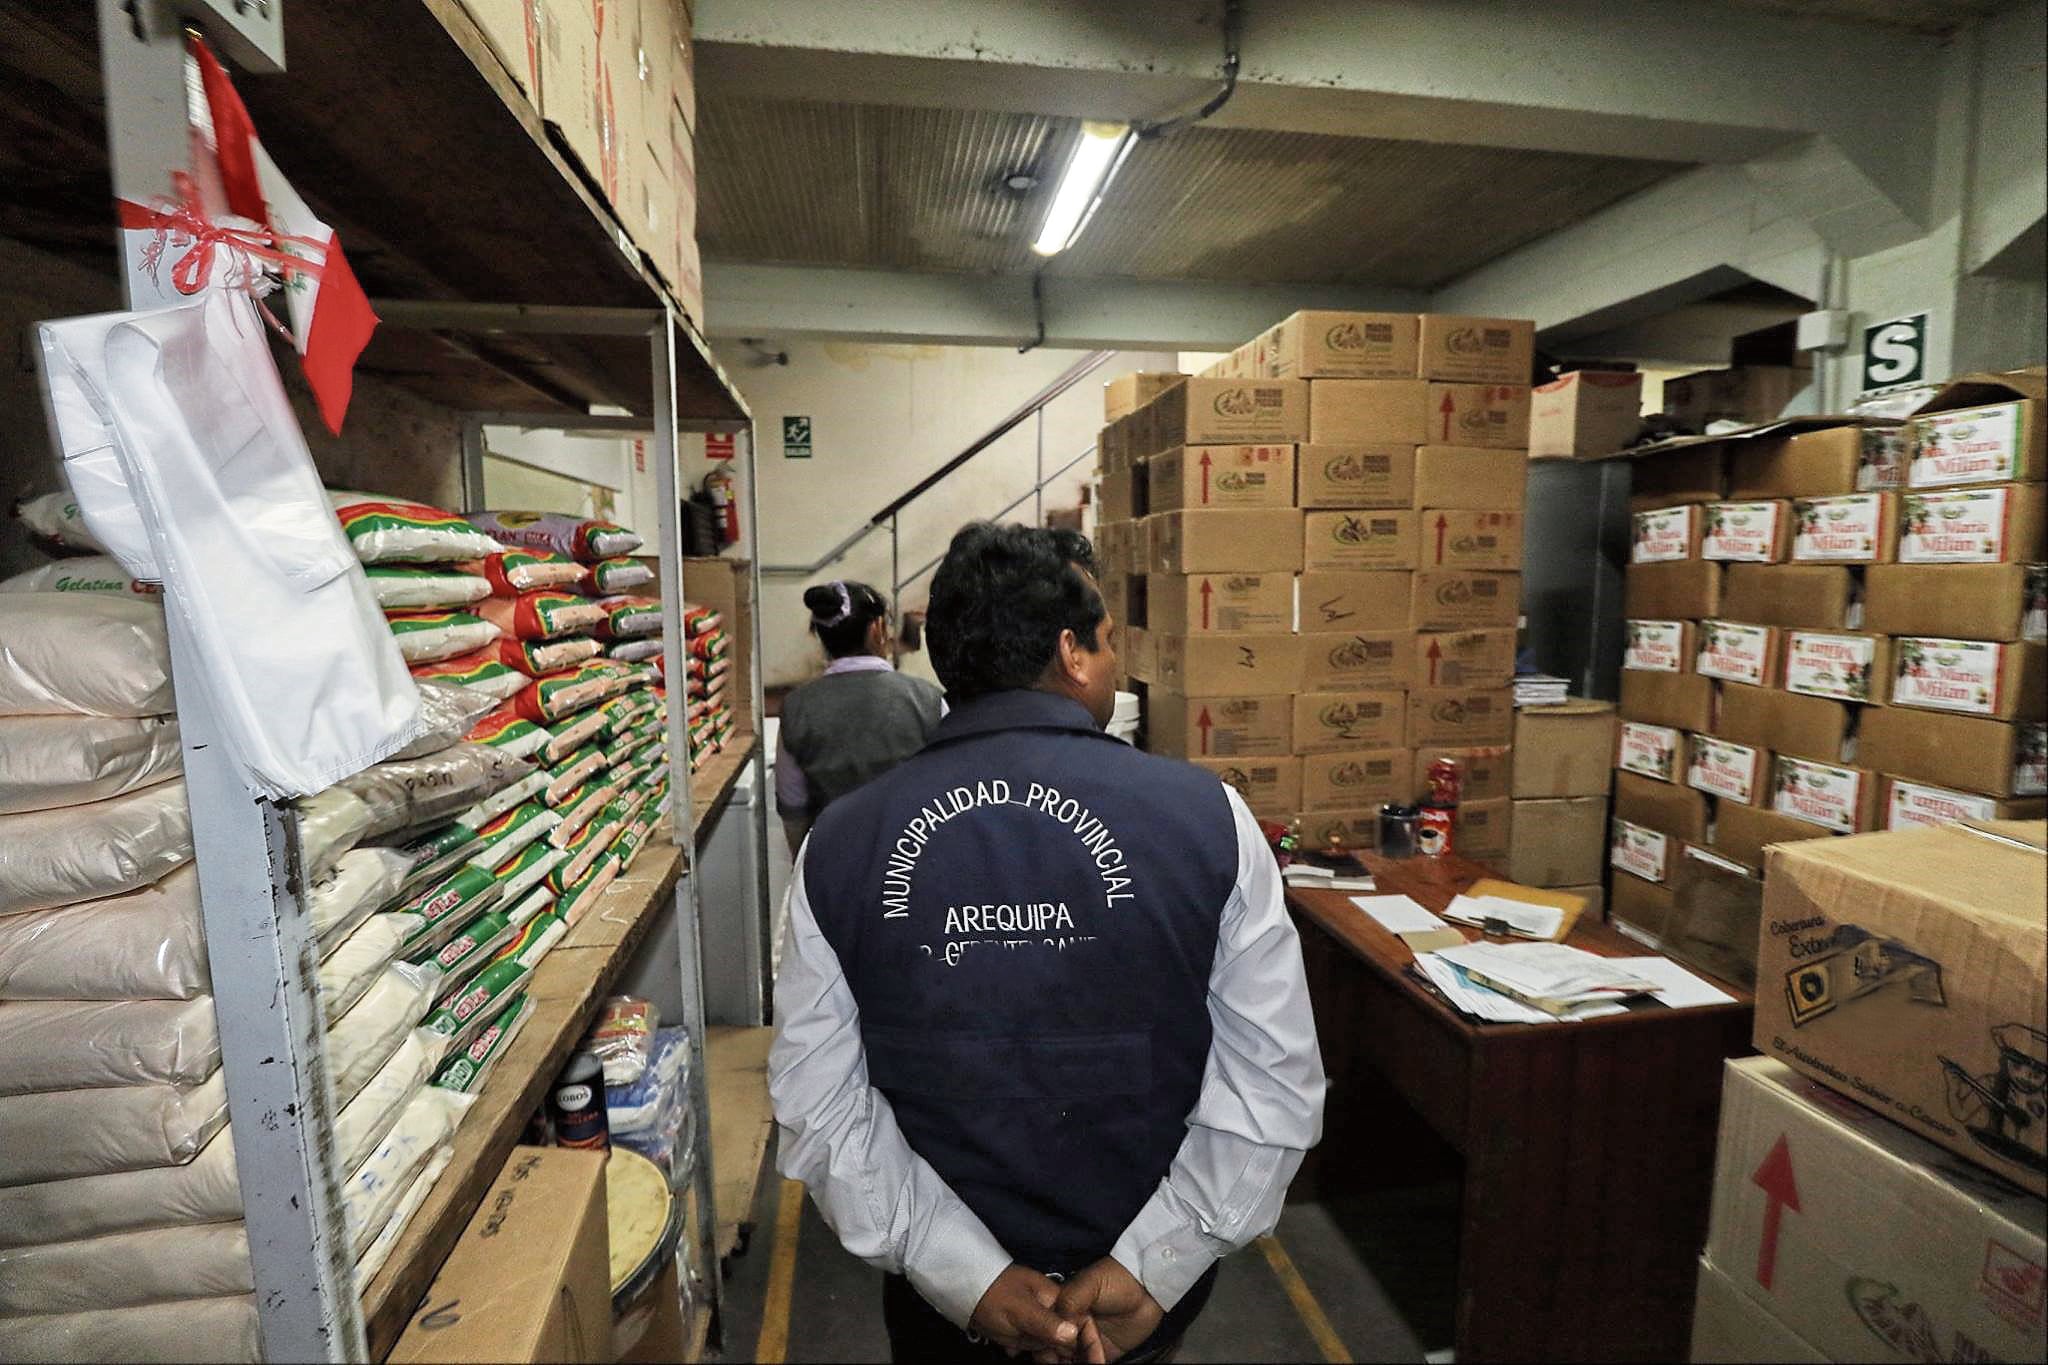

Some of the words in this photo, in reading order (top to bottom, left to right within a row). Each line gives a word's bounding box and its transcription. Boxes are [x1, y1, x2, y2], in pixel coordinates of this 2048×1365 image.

[1868, 324, 1918, 383] S
[56, 576, 123, 592] Gelatina
[883, 780, 1010, 919] MUNICIPALIDAD
[1025, 782, 1135, 909] PROVINCIAL
[944, 902, 1074, 934] AREQUIPA
